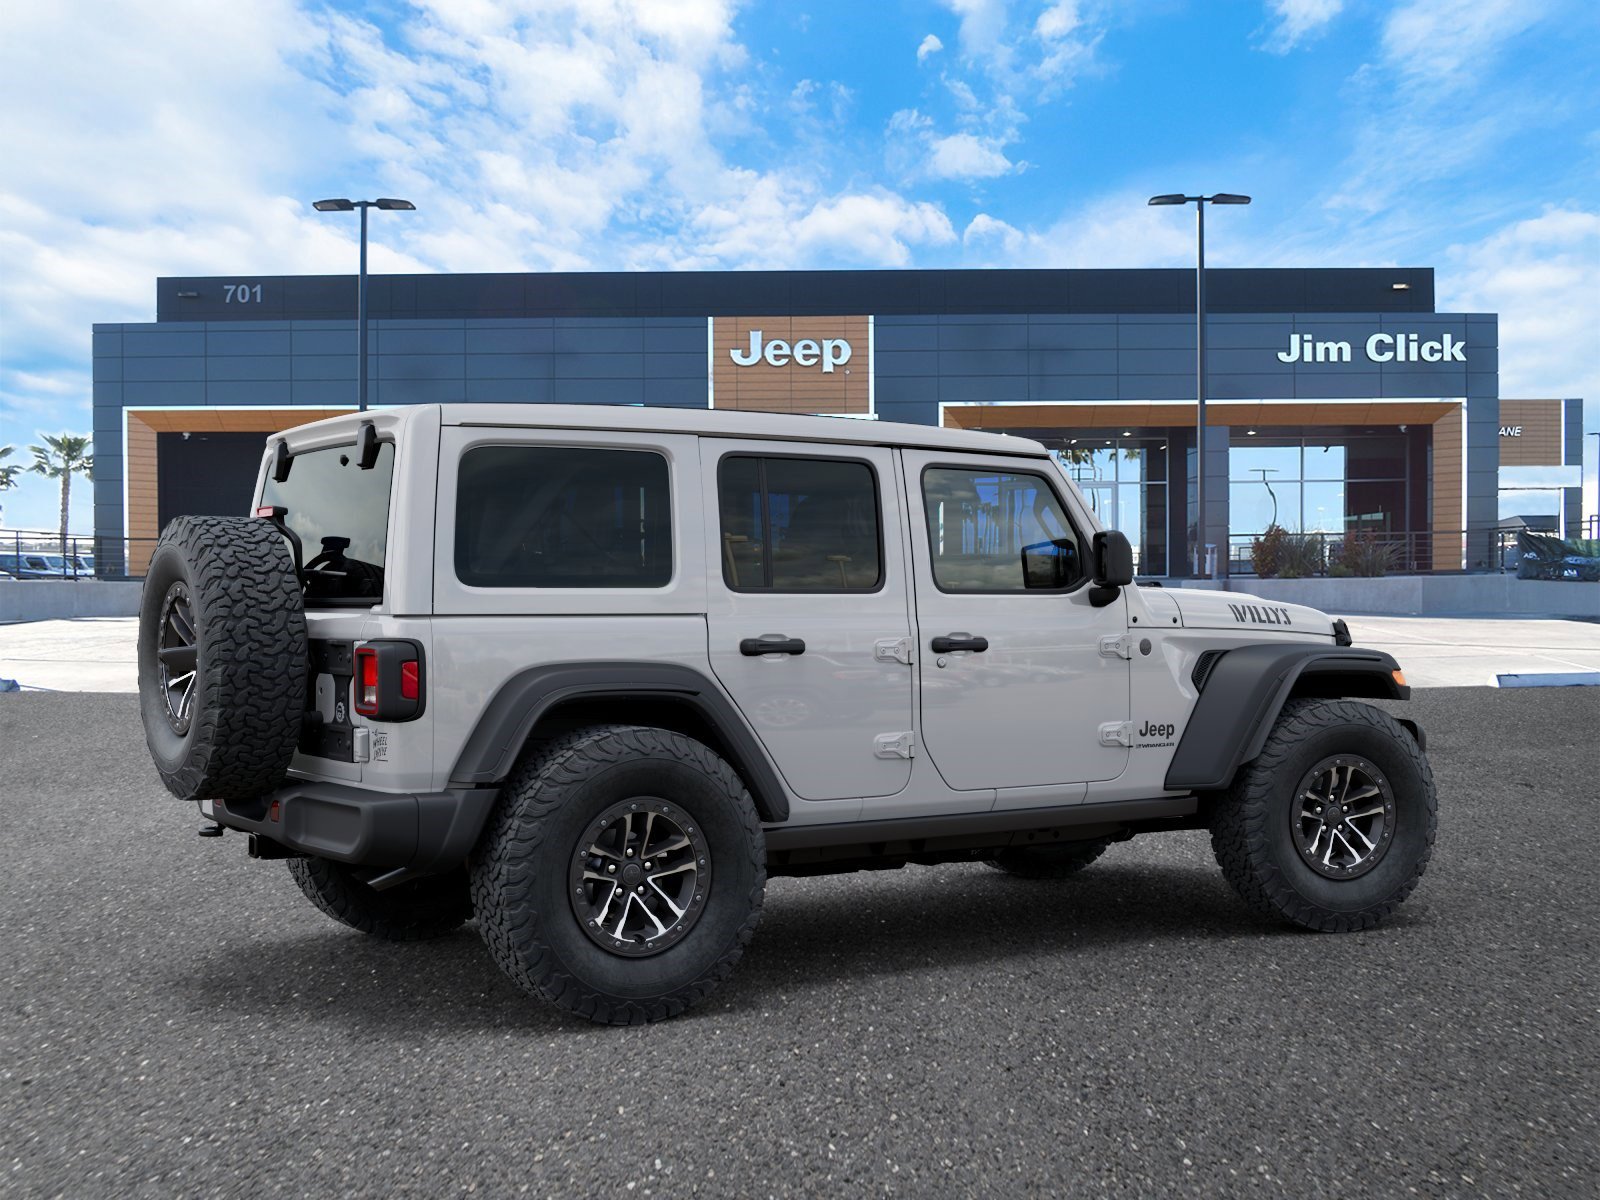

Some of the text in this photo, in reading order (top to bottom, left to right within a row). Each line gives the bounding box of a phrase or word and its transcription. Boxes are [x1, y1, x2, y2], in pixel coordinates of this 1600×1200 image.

[224, 284, 261, 303] 701
[729, 330, 852, 373] Jeep
[1277, 333, 1467, 362] Jim Click
[1499, 426, 1522, 437] ANE
[1228, 604, 1292, 625] WILLYS
[1139, 720, 1175, 739] Jeep
